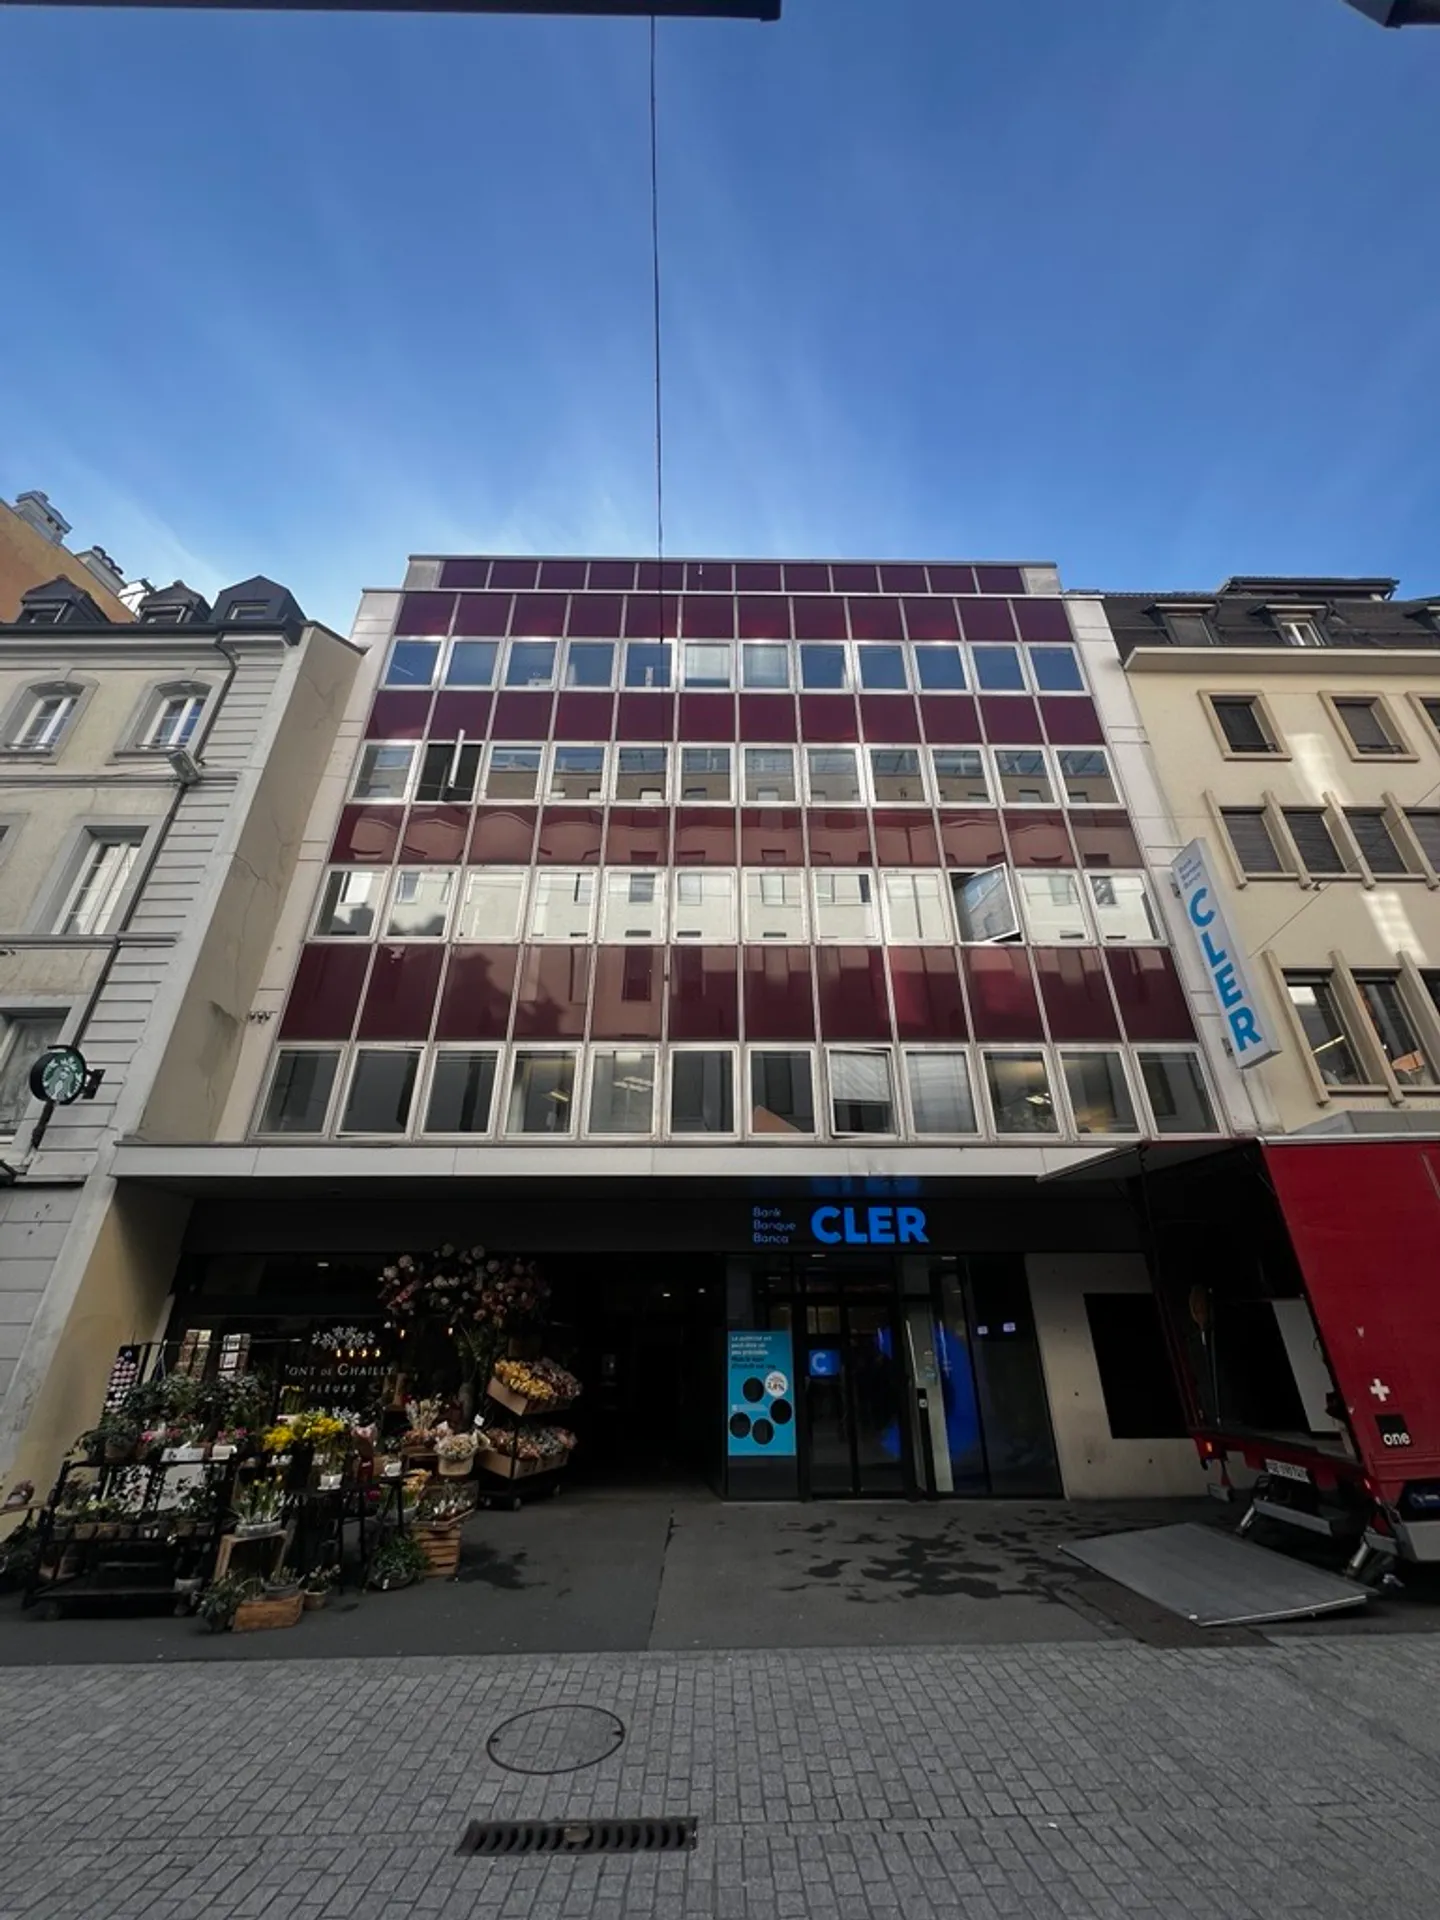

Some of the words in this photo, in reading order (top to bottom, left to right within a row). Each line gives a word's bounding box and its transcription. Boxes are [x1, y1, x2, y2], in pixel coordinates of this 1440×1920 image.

[1190, 887, 1263, 1052] CLER
[753, 1206, 781, 1217] Bank
[753, 1219, 796, 1231] Banque
[811, 1206, 929, 1244] CLER
[309, 1383, 356, 1393] FLEURS
[1383, 1433, 1411, 1445] one
